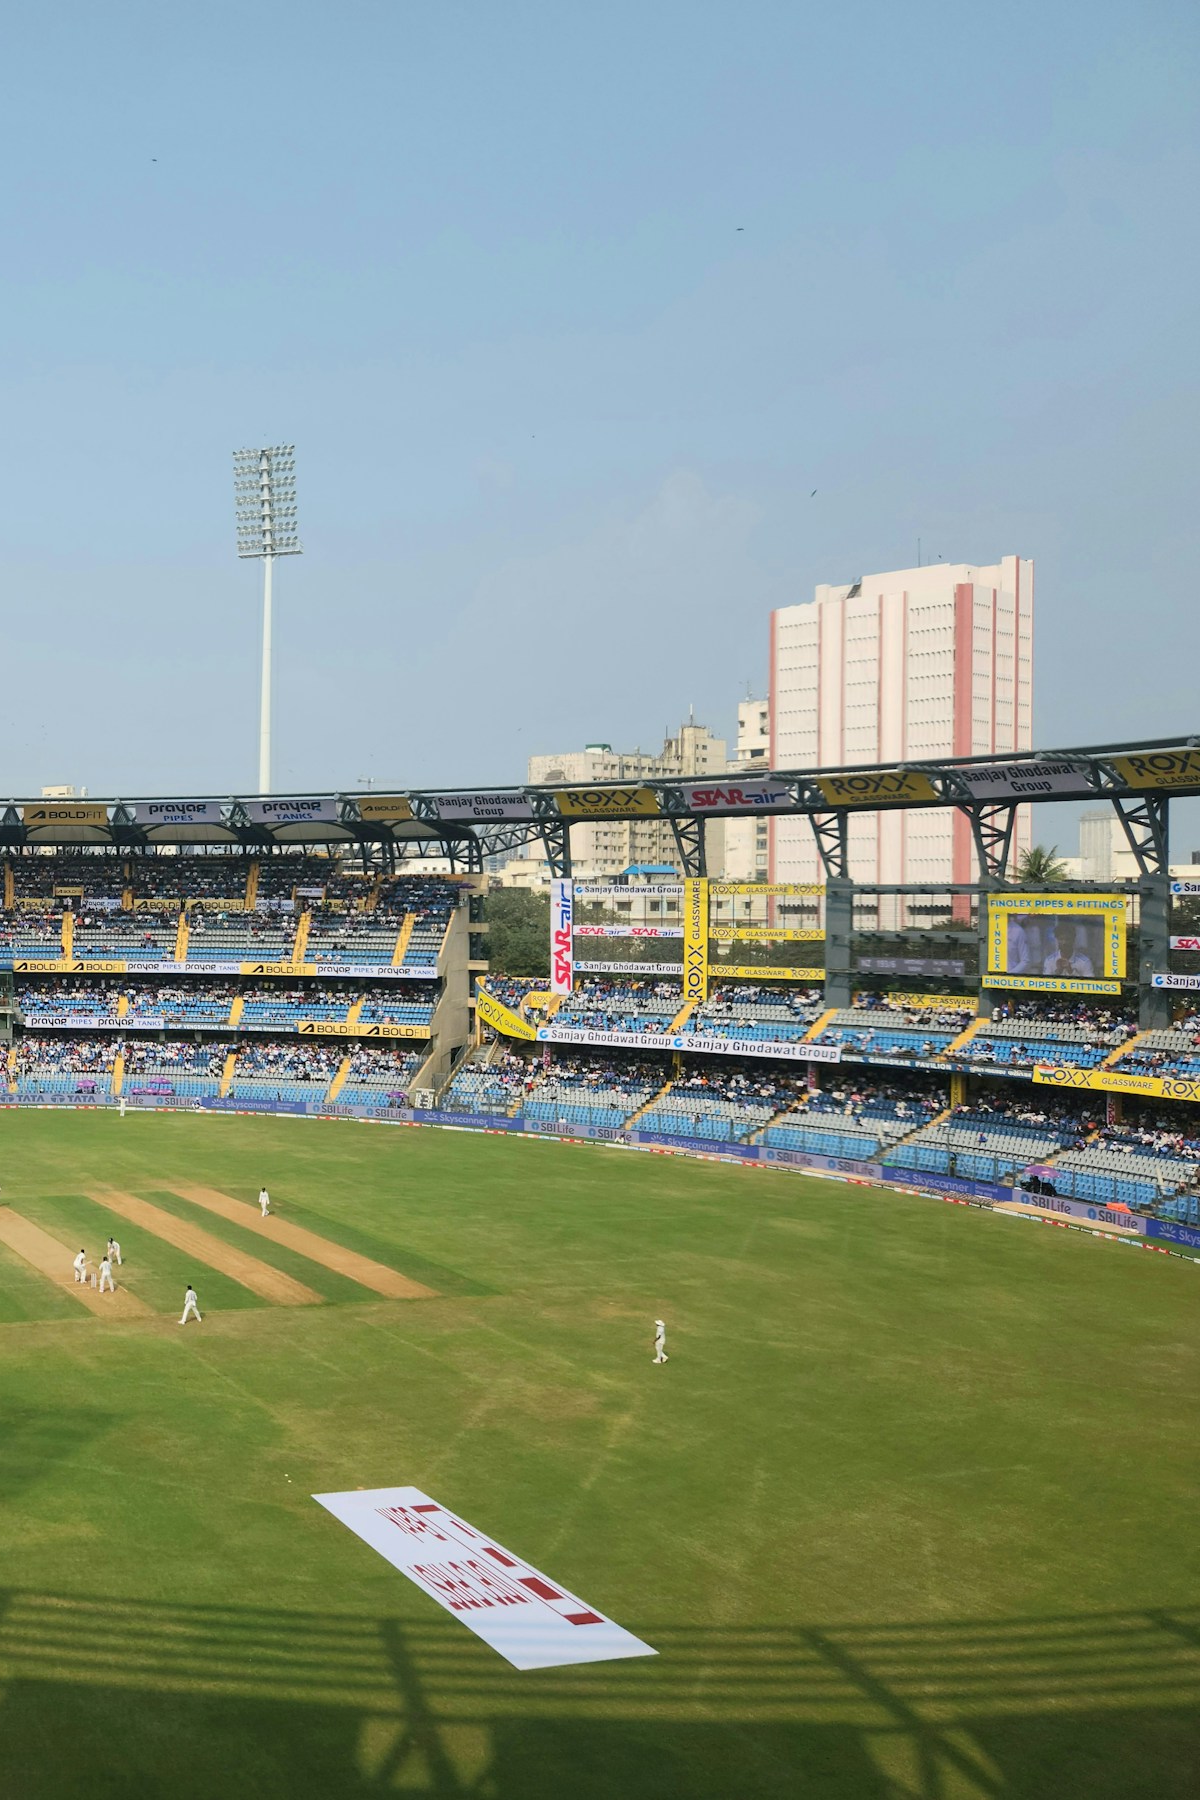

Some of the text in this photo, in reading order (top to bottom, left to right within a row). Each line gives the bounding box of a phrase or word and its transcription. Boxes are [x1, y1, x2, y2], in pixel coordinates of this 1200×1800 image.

[962, 762, 1076, 783] Sanjay Ghodawat
[829, 771, 917, 796] ROXX
[1011, 780, 1052, 793] Group
[438, 795, 527, 808] Sanjay Ghodawat
[567, 789, 642, 807] ROXX
[691, 788, 786, 807] STAR air
[850, 793, 910, 802] GLASSWARE
[148, 803, 206, 815] prayag
[262, 801, 320, 814] prayag
[473, 807, 504, 817] Group
[582, 805, 637, 814] GLASSWARE
[48, 811, 103, 819] BOLDFIT
[163, 814, 193, 822] PIPES
[274, 812, 312, 820] TANKS
[584, 885, 683, 895] Sanjay Ghodawat Group
[712, 886, 740, 894] ROXX
[793, 885, 823, 894] ROXX
[990, 900, 1032, 908] FINOLEX
[1035, 900, 1064, 908] PIPES
[1076, 900, 1124, 909] FITTINGS
[576, 927, 607, 935] STAR
[629, 927, 661, 936] STAR
[711, 929, 740, 938] ROXX
[792, 929, 823, 938] ROXX
[553, 923, 571, 991] STAR
[128, 963, 159, 972] prayag
[185, 963, 216, 973] prayag
[317, 965, 351, 975] prayag
[377, 966, 411, 976] prayag
[584, 961, 682, 973] Sanjay Ghodawat Group
[688, 944, 704, 998] ROXX
[711, 966, 739, 976] ROXX
[791, 968, 823, 978] ROXX
[985, 978, 1025, 987] FINOLEX
[1028, 980, 1057, 989] PIPES
[1070, 982, 1118, 992] FITTINGS
[31, 1016, 67, 1028] prayag
[71, 1018, 93, 1026] PIPES
[98, 1017, 134, 1029] prayag
[551, 1029, 672, 1048] Sanjay Ghodawat Group
[687, 1037, 730, 1053] Sanjay
[732, 1040, 796, 1056] Ghodawat
[799, 1046, 837, 1061] Group
[1102, 1077, 1154, 1089] GLASSWARE
[16, 1095, 45, 1103] TATA
[67, 1095, 96, 1103] TATA
[226, 1100, 272, 1111] Skyscanner
[439, 1113, 488, 1127] Skyscanner
[668, 1137, 720, 1151] Skyscanner
[913, 1173, 969, 1193] Skyscanner
[1031, 1195, 1050, 1209] SBI
